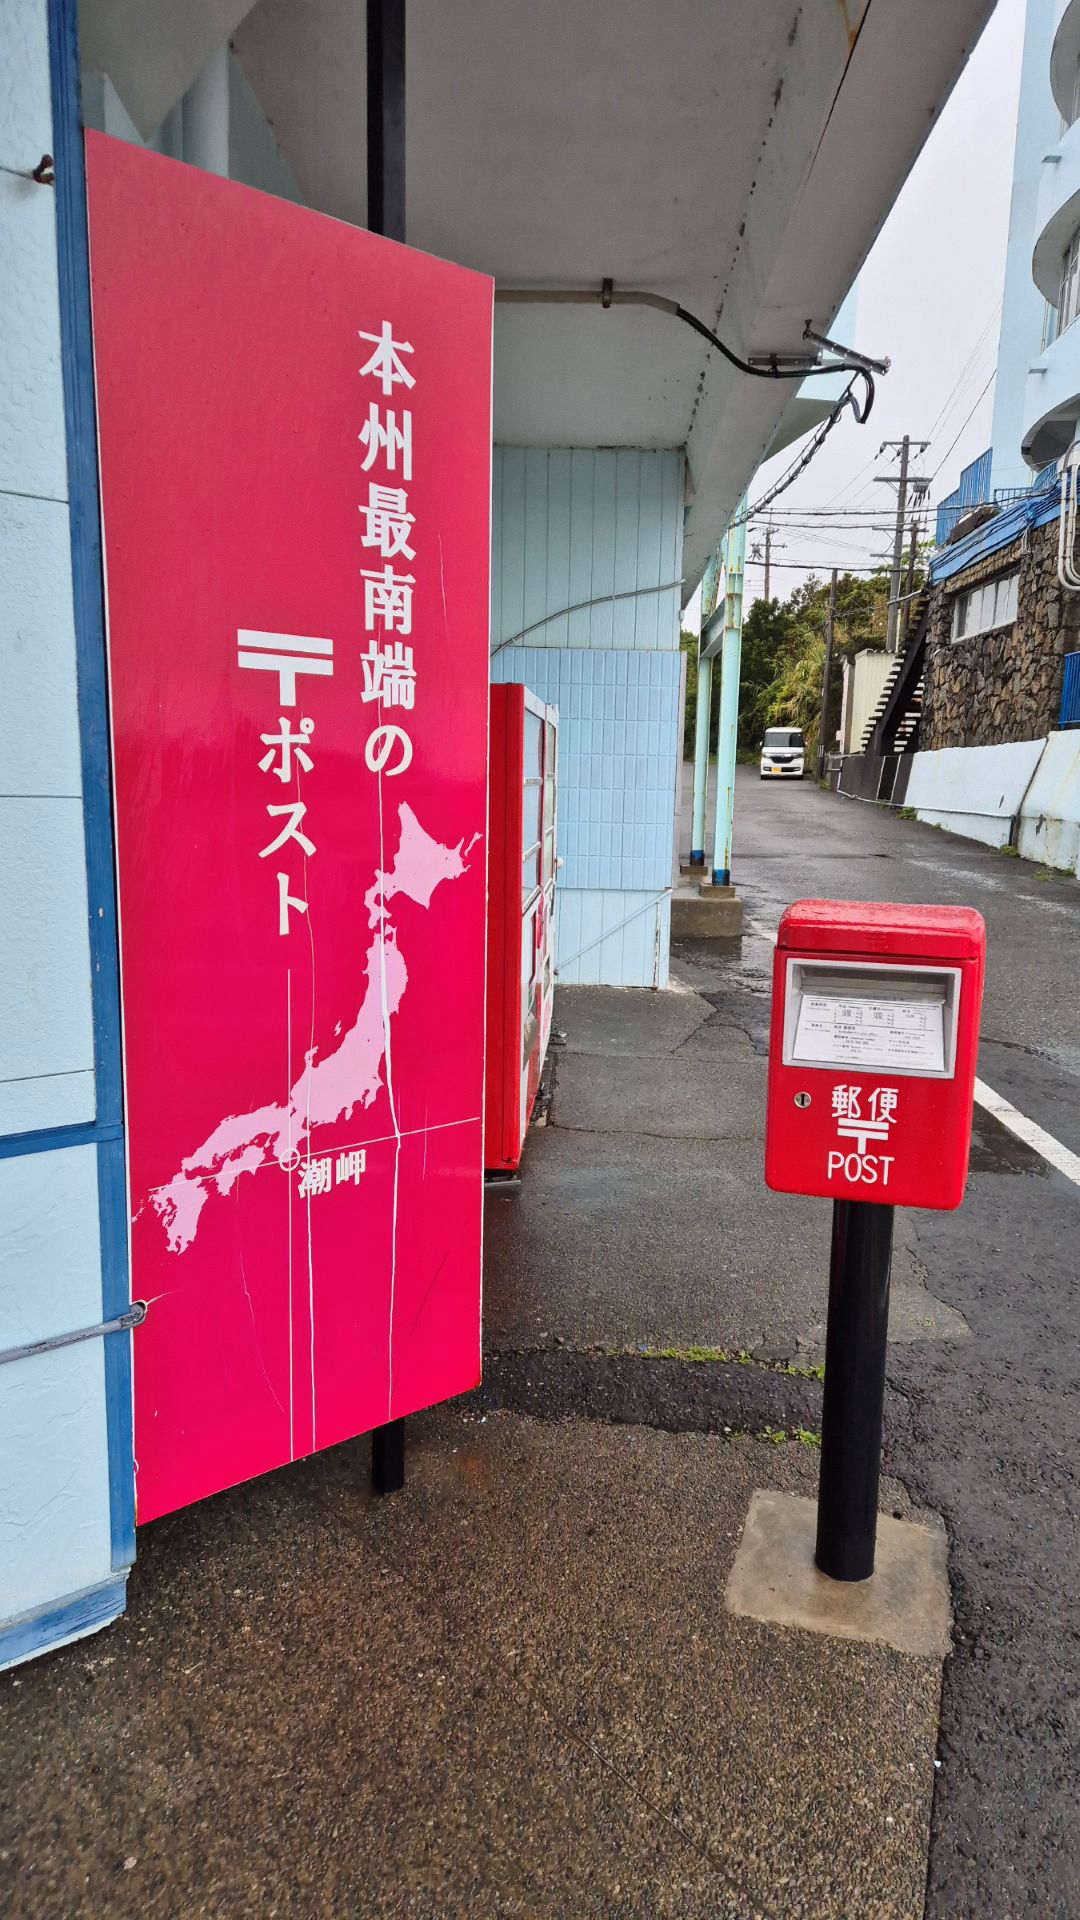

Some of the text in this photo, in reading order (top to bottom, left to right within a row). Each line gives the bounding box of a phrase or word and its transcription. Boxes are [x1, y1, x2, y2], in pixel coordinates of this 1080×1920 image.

[358, 320, 416, 776] 本州最南端の
[831, 1084, 899, 1123] 郵便
[297, 1149, 366, 1199] 潮岬
[827, 1151, 895, 1186] POST
